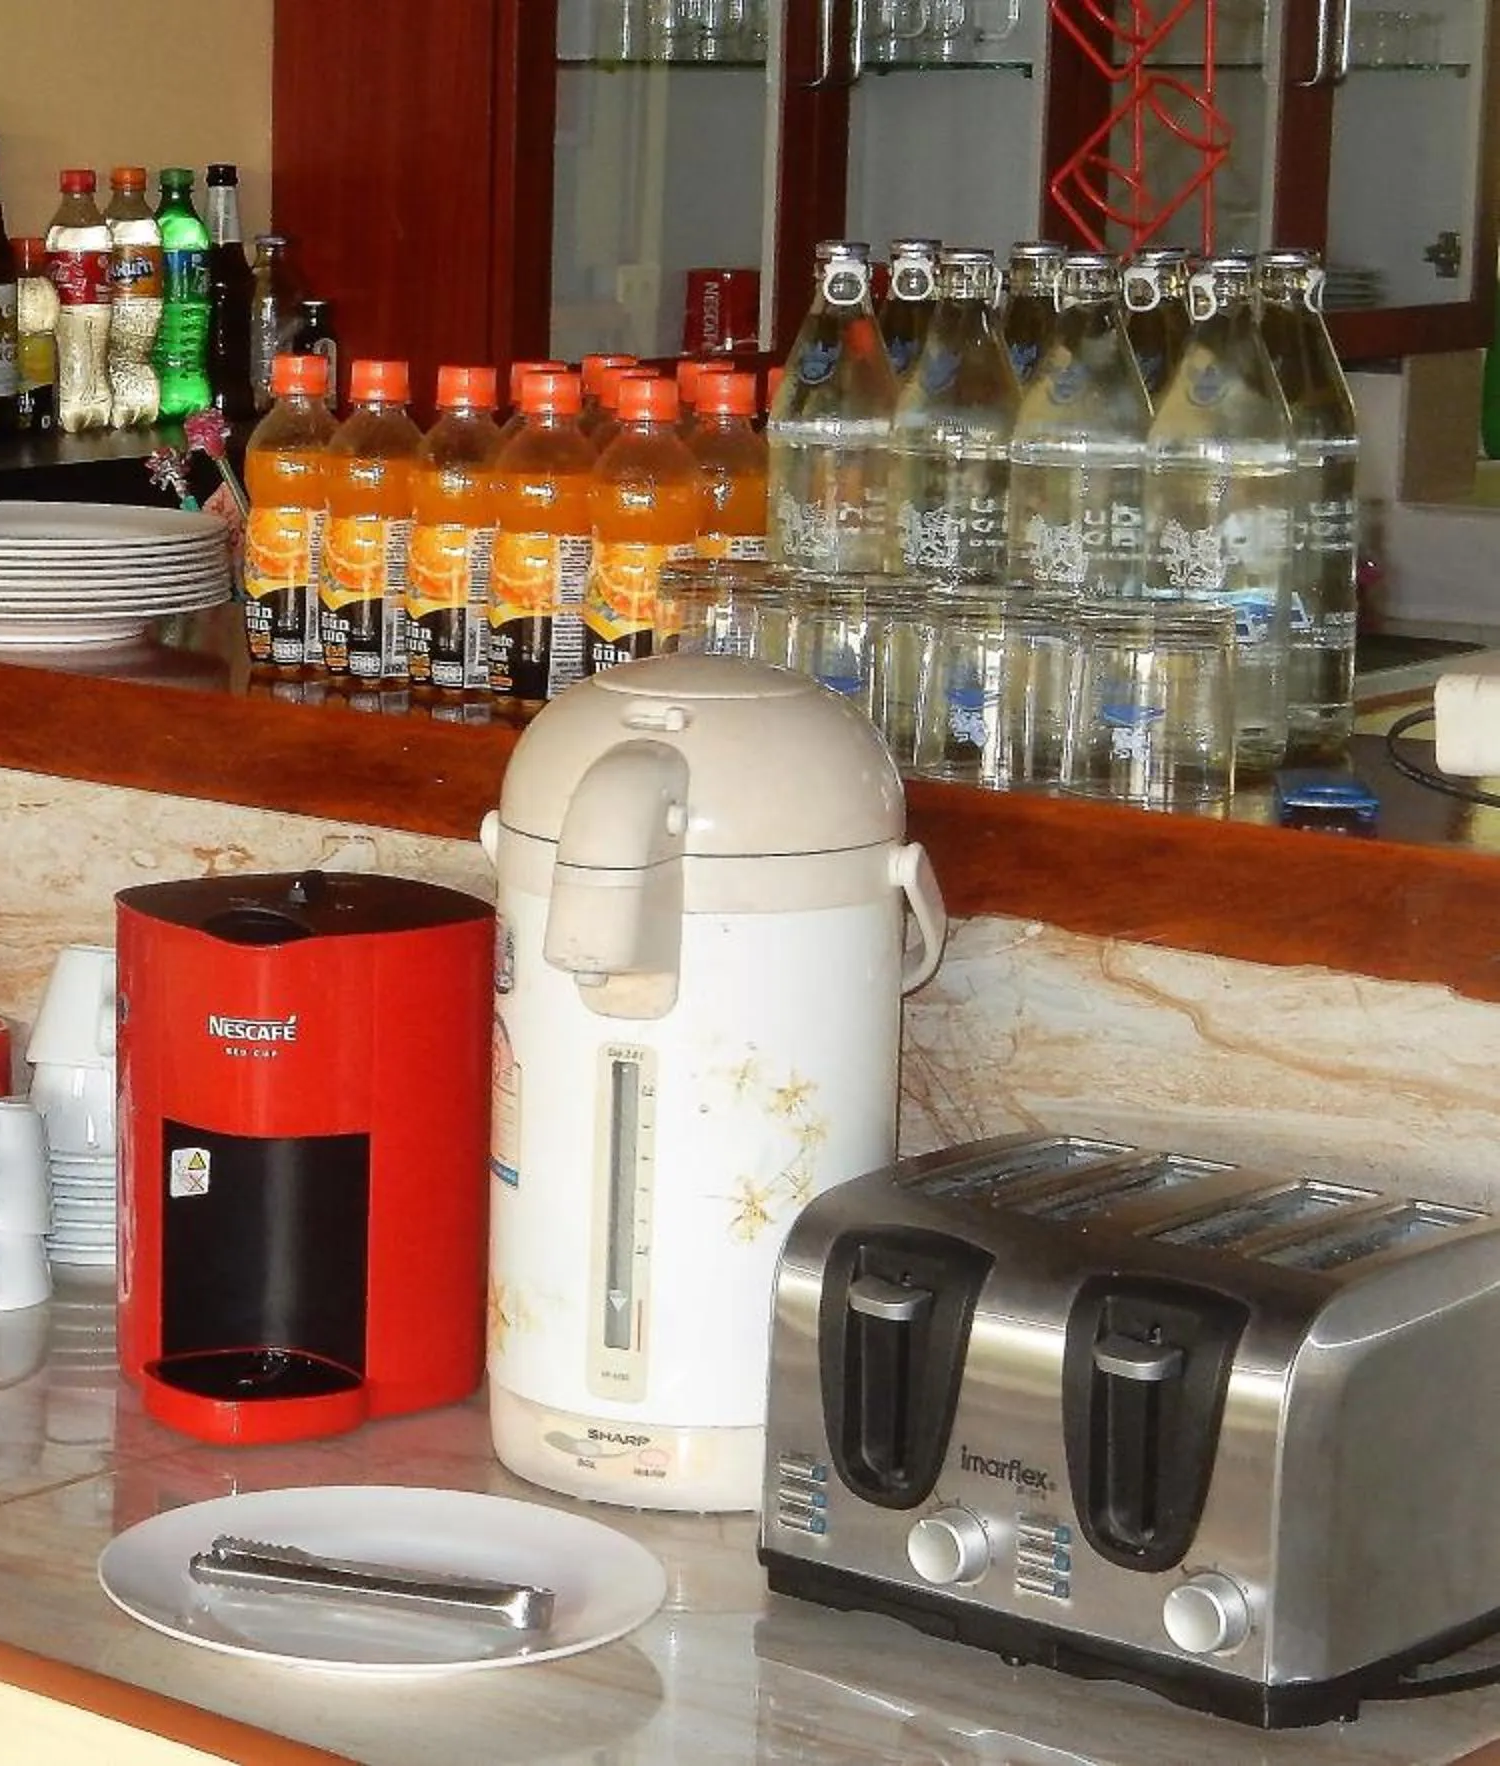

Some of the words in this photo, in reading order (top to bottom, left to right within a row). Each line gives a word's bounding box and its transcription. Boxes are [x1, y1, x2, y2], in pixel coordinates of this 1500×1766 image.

[703, 281, 719, 340] NESCAF
[208, 1013, 298, 1042] NESCAFÉ
[587, 1428, 651, 1447] SHARP
[961, 1444, 1048, 1491] imarflex
